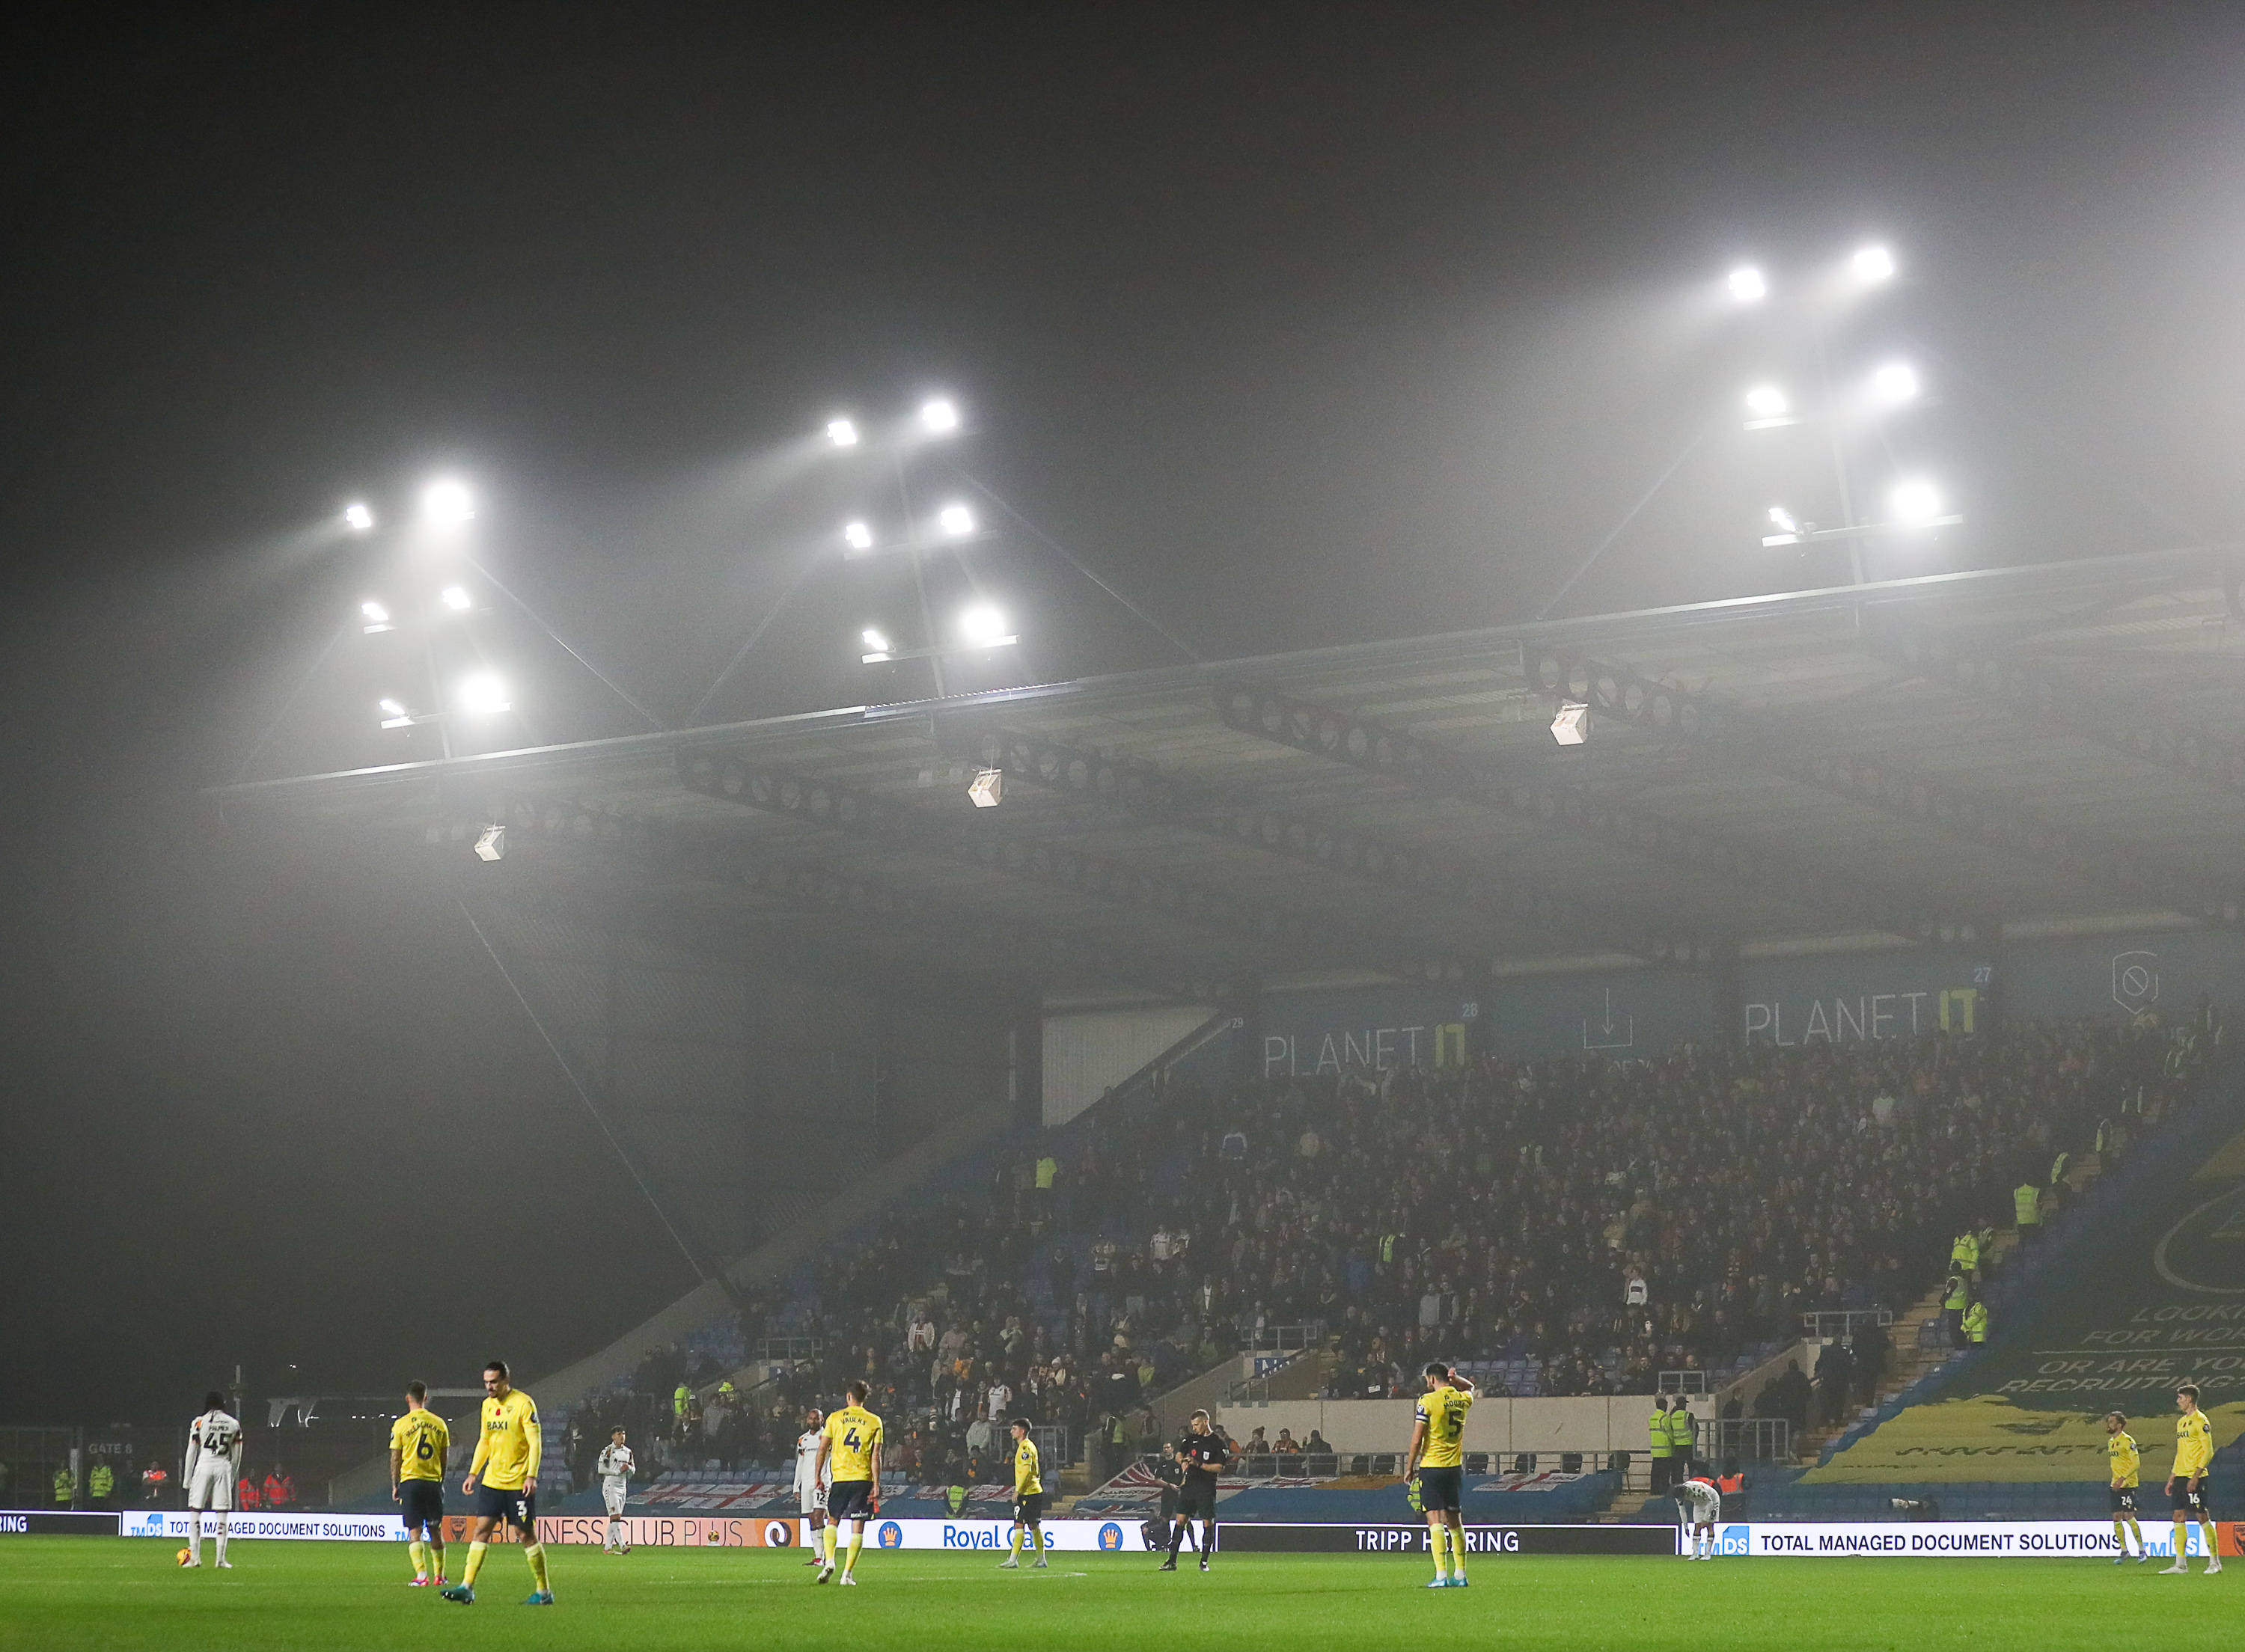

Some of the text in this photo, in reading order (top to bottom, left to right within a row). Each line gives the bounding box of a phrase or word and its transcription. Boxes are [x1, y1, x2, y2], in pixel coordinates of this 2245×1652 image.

[1973, 966, 1993, 982] 27
[1461, 1002, 1479, 1018] 28
[1745, 988, 1978, 1047] PLANET IT
[1231, 1017, 1244, 1030] 29
[1264, 1026, 1425, 1079] PLANET
[2131, 1304, 2245, 1322] LOOKI
[2080, 1329, 2162, 1344] FOR
[2037, 1355, 2245, 1374] OR ARE YO
[486, 1421, 507, 1431] BAXI
[1448, 1410, 1463, 1437] 5
[88, 1443, 123, 1455] GATE
[203, 1432, 232, 1455] 45
[417, 1433, 434, 1460] 6
[843, 1427, 861, 1454] 4
[816, 1492, 826, 1502] 12
[2121, 1496, 2133, 1505] 24
[2188, 1493, 2200, 1505] 16
[516, 1500, 528, 1517] 3
[170, 1521, 385, 1538] TOT MAGED DOCUMENT SOLUTIONS
[491, 1519, 605, 1545] BINESS
[944, 1524, 1054, 1550] Royal Cas
[1355, 1530, 1519, 1552] TRIPP HRING
[1761, 1534, 2122, 1552] TOTAL MANAGED DOCUMENT SOLUTIONS
